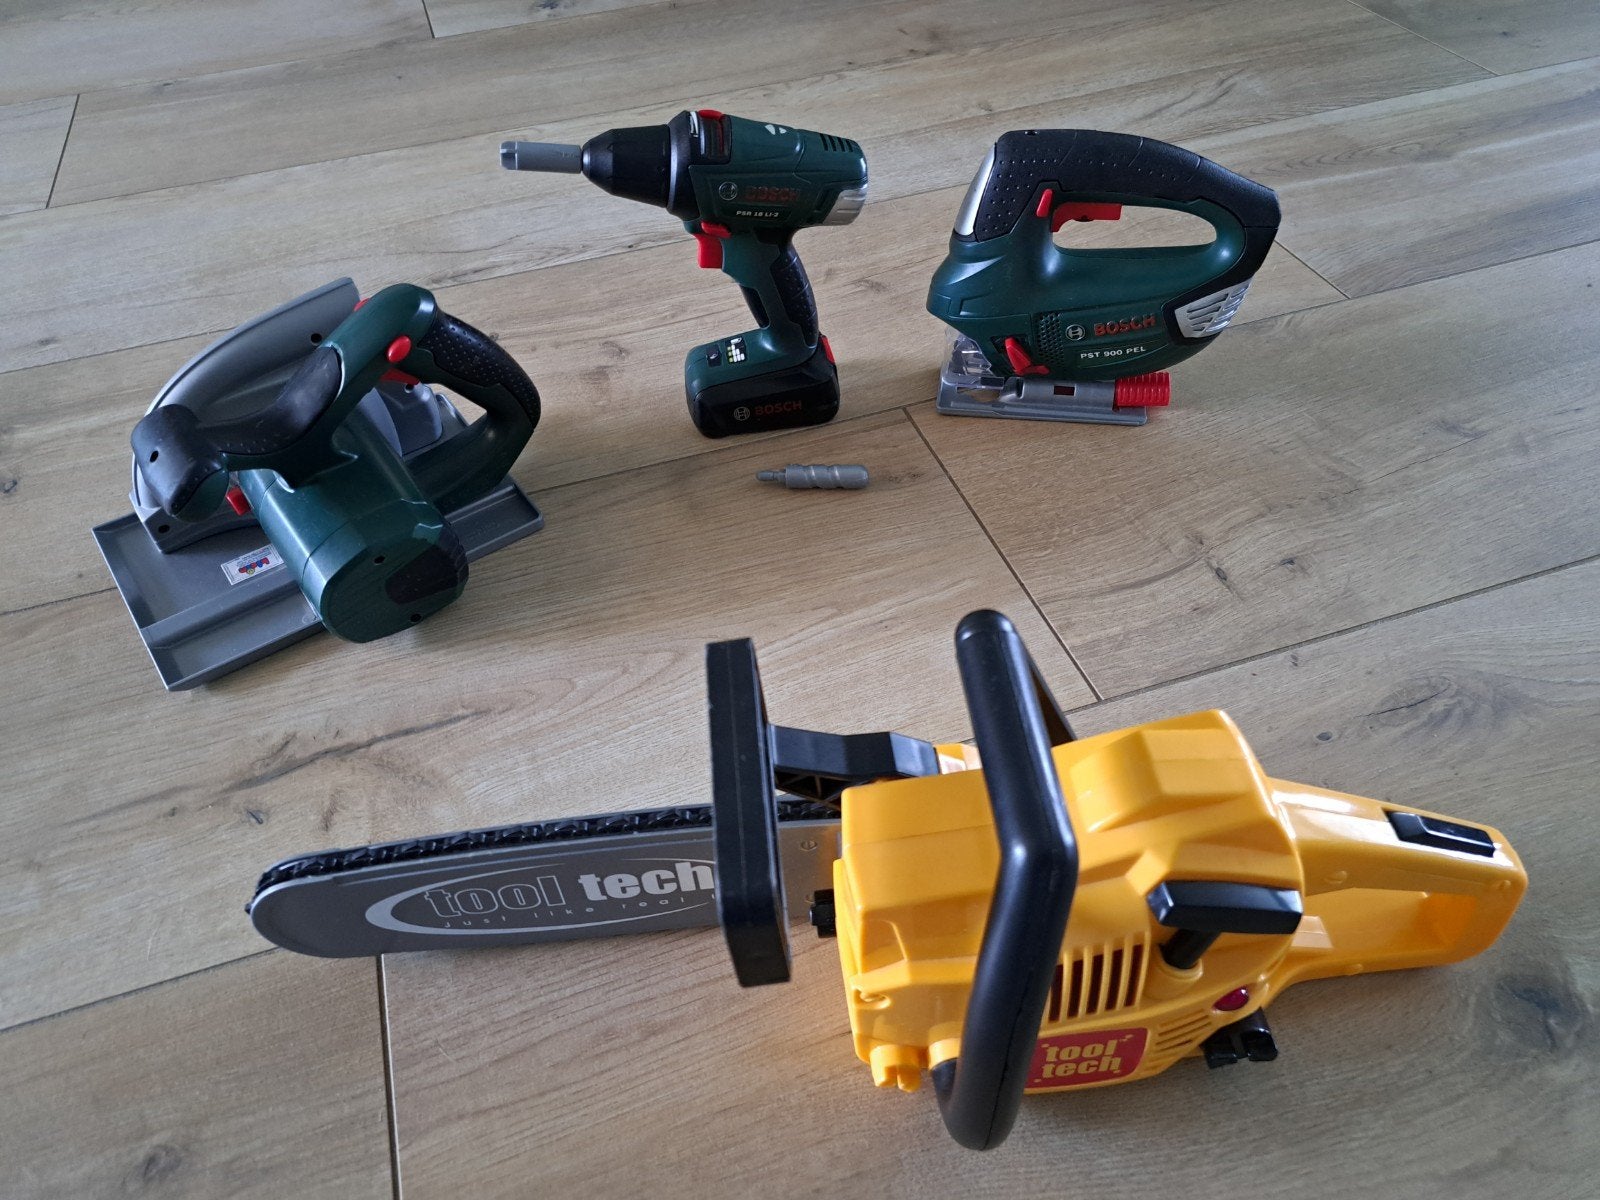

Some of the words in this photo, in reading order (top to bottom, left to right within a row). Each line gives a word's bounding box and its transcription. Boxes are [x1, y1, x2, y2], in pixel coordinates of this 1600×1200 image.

[1093, 313, 1156, 337] BOSCH
[1080, 351, 1100, 359] PST
[1103, 349, 1123, 357] 900
[1126, 346, 1146, 354] PEL
[755, 401, 802, 416] BOSCH
[424, 875, 566, 918] tool
[578, 861, 715, 901] tech
[533, 907, 594, 919] like
[622, 896, 685, 910] real
[1041, 1039, 1118, 1062] tool
[1041, 1056, 1122, 1079] tech
